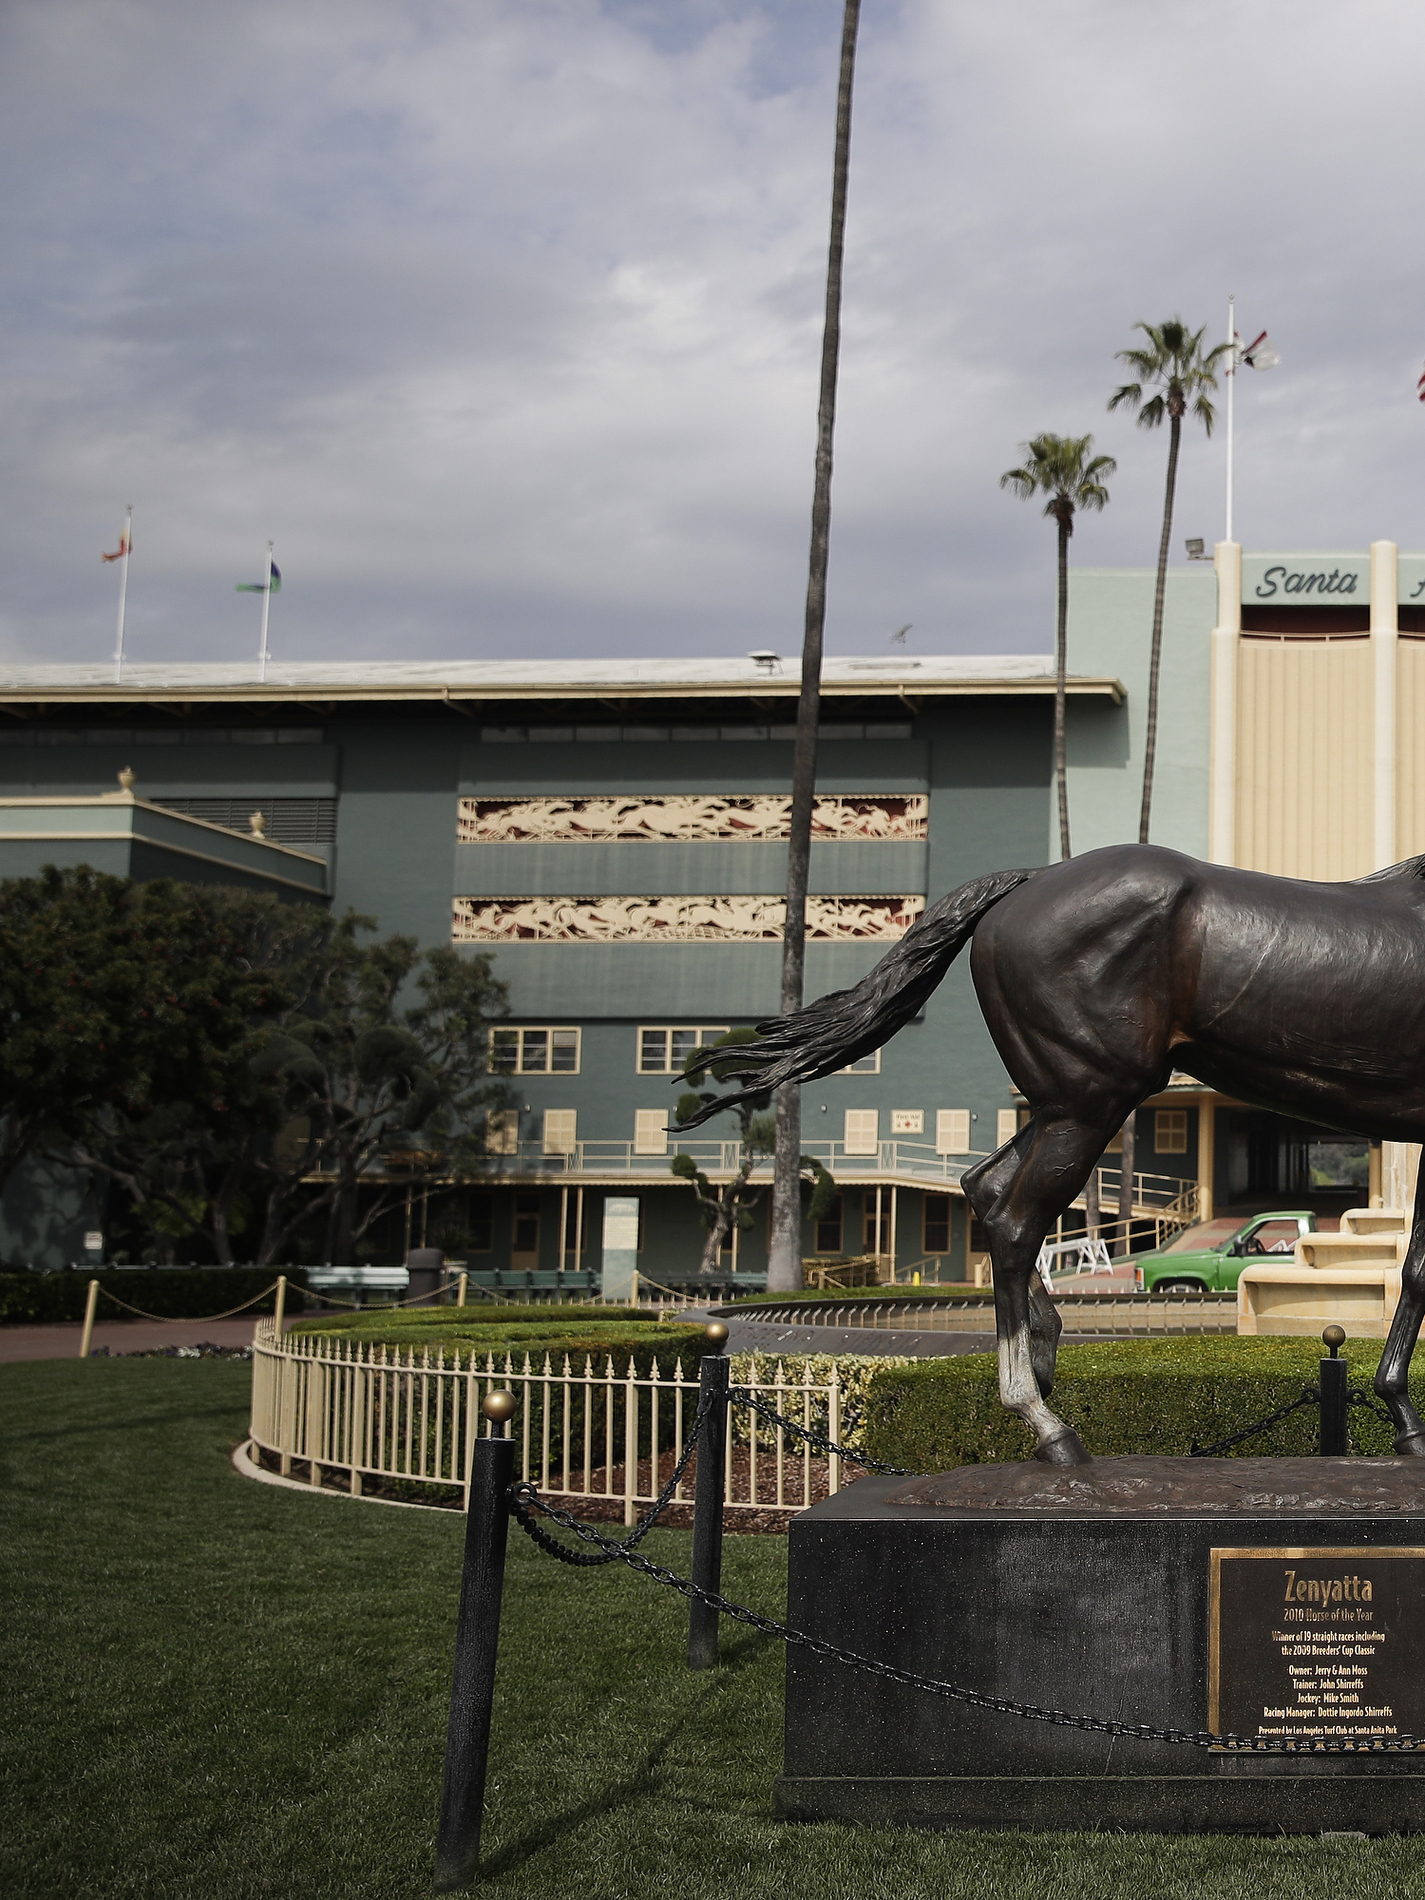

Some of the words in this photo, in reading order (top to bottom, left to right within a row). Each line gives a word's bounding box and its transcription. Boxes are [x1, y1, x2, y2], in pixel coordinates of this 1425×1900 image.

[1255, 566, 1359, 598] Santa
[1284, 1570, 1373, 1608] Zenyatta
[1284, 1609, 1304, 1622] 2010
[1306, 1609, 1329, 1622] Horse
[1331, 1608, 1341, 1622] of
[1341, 1608, 1355, 1622] the
[1356, 1608, 1374, 1622] Year
[1272, 1631, 1295, 1642] Winner
[1296, 1630, 1304, 1641] of
[1304, 1631, 1312, 1641] 19
[1312, 1631, 1338, 1644] straight
[1338, 1632, 1355, 1642] races
[1355, 1631, 1386, 1644] including
[1281, 1645, 1293, 1656] the
[1293, 1645, 1311, 1656] 2009
[1341, 1645, 1354, 1657] Cup
[1354, 1645, 1376, 1656] Classic
[1288, 1665, 1313, 1676] Owner:
[1314, 1665, 1332, 1677] Jerry
[1332, 1665, 1338, 1676] &
[1338, 1665, 1352, 1676] Ann
[1351, 1665, 1368, 1676] Moss
[1292, 1679, 1318, 1690] Trainer:
[1319, 1679, 1336, 1690] John
[1336, 1679, 1364, 1690] Shirreffs
[1297, 1693, 1321, 1705] Jockey:
[1323, 1693, 1339, 1704] Mike
[1339, 1693, 1360, 1704] Smith
[1263, 1707, 1285, 1719] Racing
[1286, 1707, 1316, 1719] Manager:
[1318, 1707, 1339, 1718] Dottie
[1339, 1707, 1364, 1719] Ingordo
[1364, 1707, 1393, 1718] Shirreffs
[1258, 1726, 1285, 1736] Presented
[1285, 1726, 1293, 1736] by
[1293, 1726, 1303, 1736] Los
[1303, 1726, 1324, 1736] Angeles
[1324, 1726, 1336, 1735] Turf
[1336, 1726, 1348, 1735] Club
[1348, 1727, 1355, 1735] at
[1354, 1726, 1370, 1735] Santa
[1370, 1726, 1385, 1735] Anita
[1385, 1726, 1397, 1735] Park
